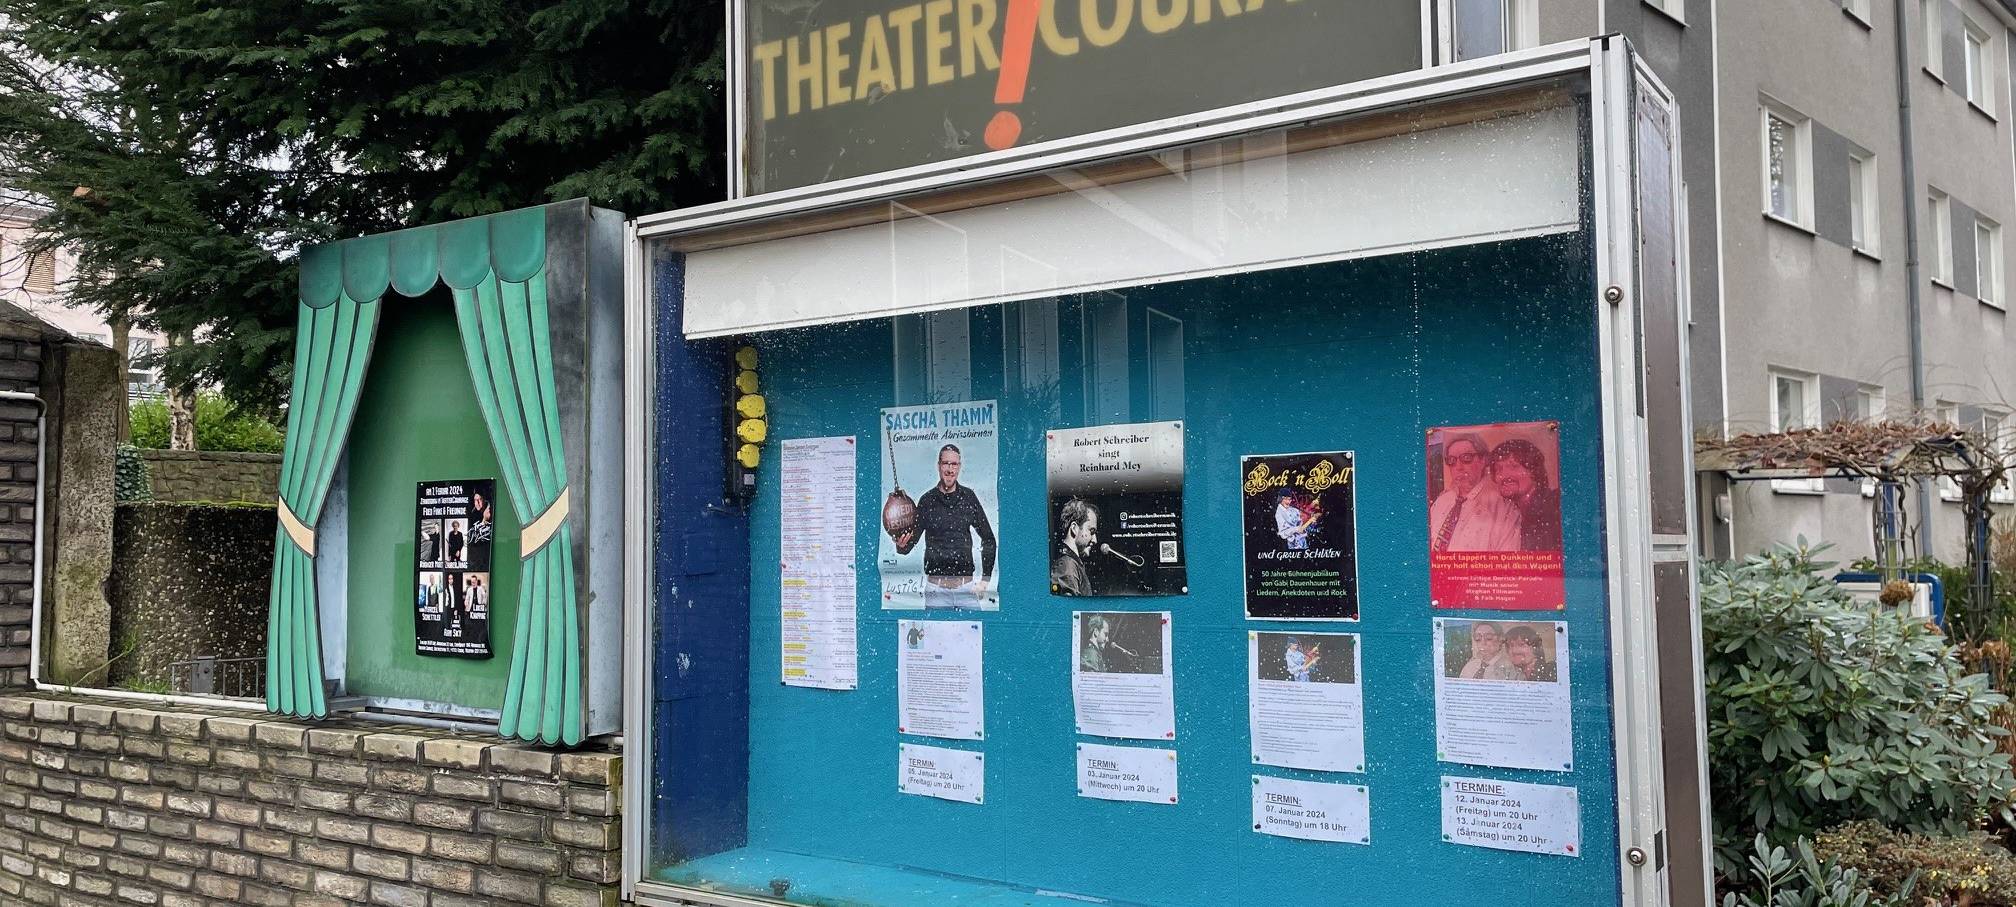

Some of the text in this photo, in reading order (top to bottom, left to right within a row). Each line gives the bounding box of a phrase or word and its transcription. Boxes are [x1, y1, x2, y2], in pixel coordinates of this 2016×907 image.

[753, 0, 1000, 121] THEATER
[886, 406, 993, 430] SASCHA THAMM
[893, 429, 993, 443] Gesammelte Abrissbirnen
[1074, 434, 1150, 447] Robert Schreiber
[1098, 449, 1120, 460] singt
[1080, 460, 1142, 472] Reinhard Mey
[1244, 462, 1290, 497] Rock
[1305, 459, 1354, 494] Roll
[908, 776, 932, 787] (Freitag)
[939, 772, 953, 780] 2024
[1099, 772, 1121, 780] Januar
[1122, 773, 1140, 781] 2024
[1087, 780, 1122, 792] (Mittwoch)
[1455, 795, 1521, 808] 12. Januar 2024
[1278, 806, 1305, 816] Januar
[1306, 810, 1326, 819] 2024
[1455, 805, 1491, 818] (Freitag)
[1509, 811, 1519, 819] 20
[1521, 812, 1539, 821] Uhr
[1265, 816, 1302, 829] (Sonntag)
[1331, 824, 1348, 832] Uhr
[1456, 817, 1469, 825] 13.
[1502, 821, 1523, 830] 2024
[1517, 834, 1528, 843] 20
